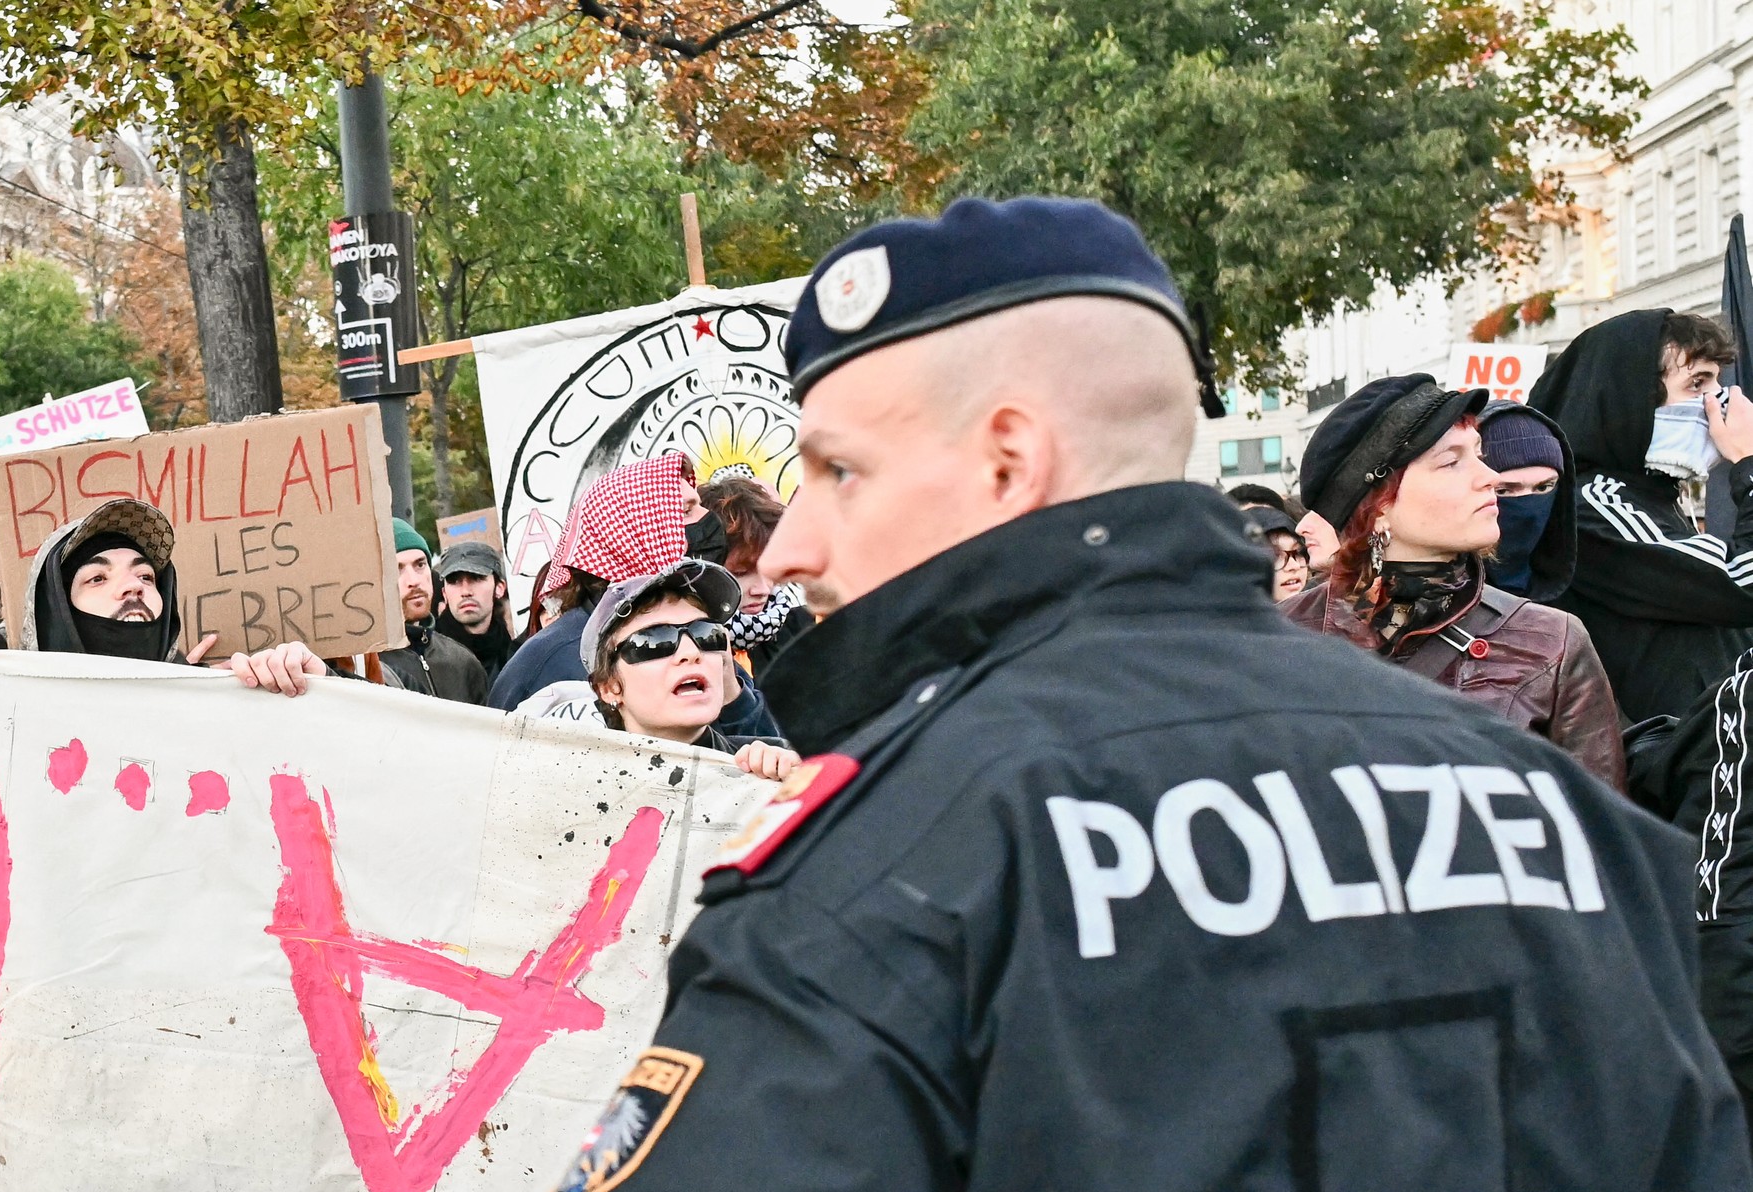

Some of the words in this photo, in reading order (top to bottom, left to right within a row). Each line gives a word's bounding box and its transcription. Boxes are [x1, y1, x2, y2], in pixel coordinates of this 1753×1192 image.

[340, 331, 382, 350] 300m
[1464, 355, 1522, 385] NO
[214, 521, 301, 577] LES
[1045, 764, 1606, 959] POLIZEI
